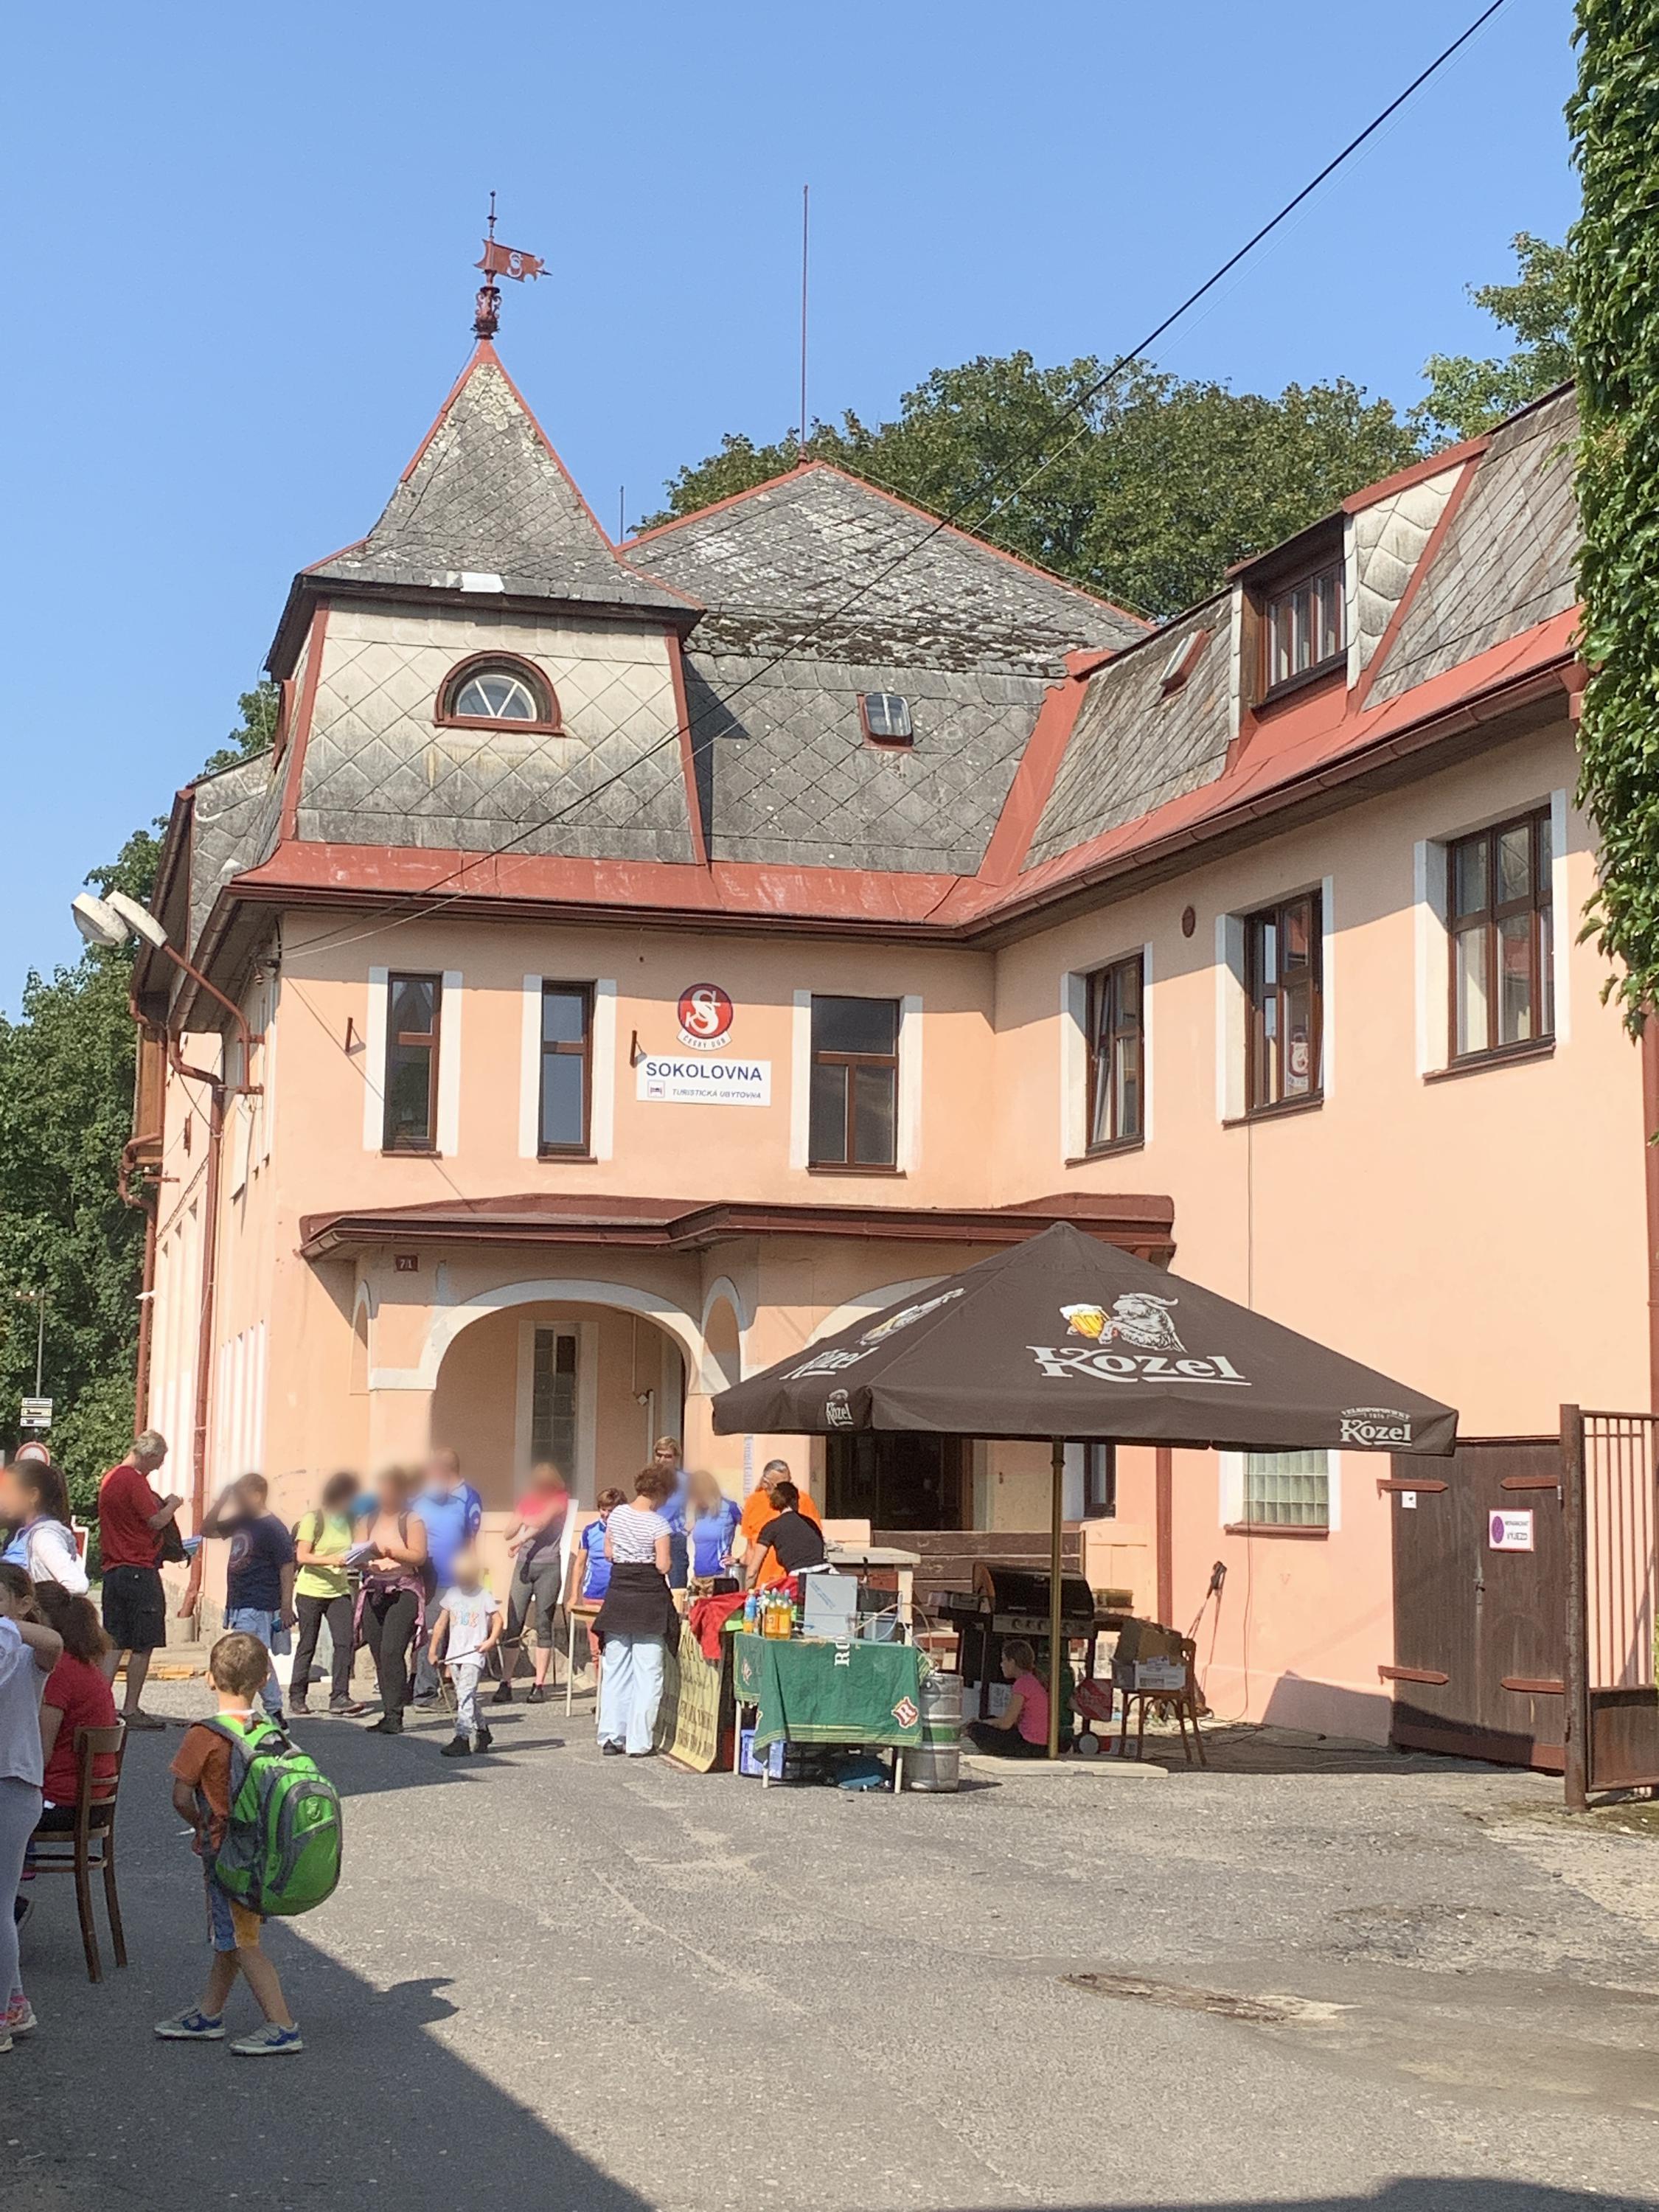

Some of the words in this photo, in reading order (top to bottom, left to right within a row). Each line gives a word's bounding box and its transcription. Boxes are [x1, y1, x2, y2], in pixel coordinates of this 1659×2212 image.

[646, 1062, 762, 1081] SOKOLOVNA
[672, 1088, 717, 1097] TURISTICKÁ
[719, 1091, 761, 1099] UBYTOVNA
[1026, 1345, 1252, 1385] Kozel
[825, 1402, 854, 1427] Kozel
[1340, 1418, 1413, 1446] Kozel
